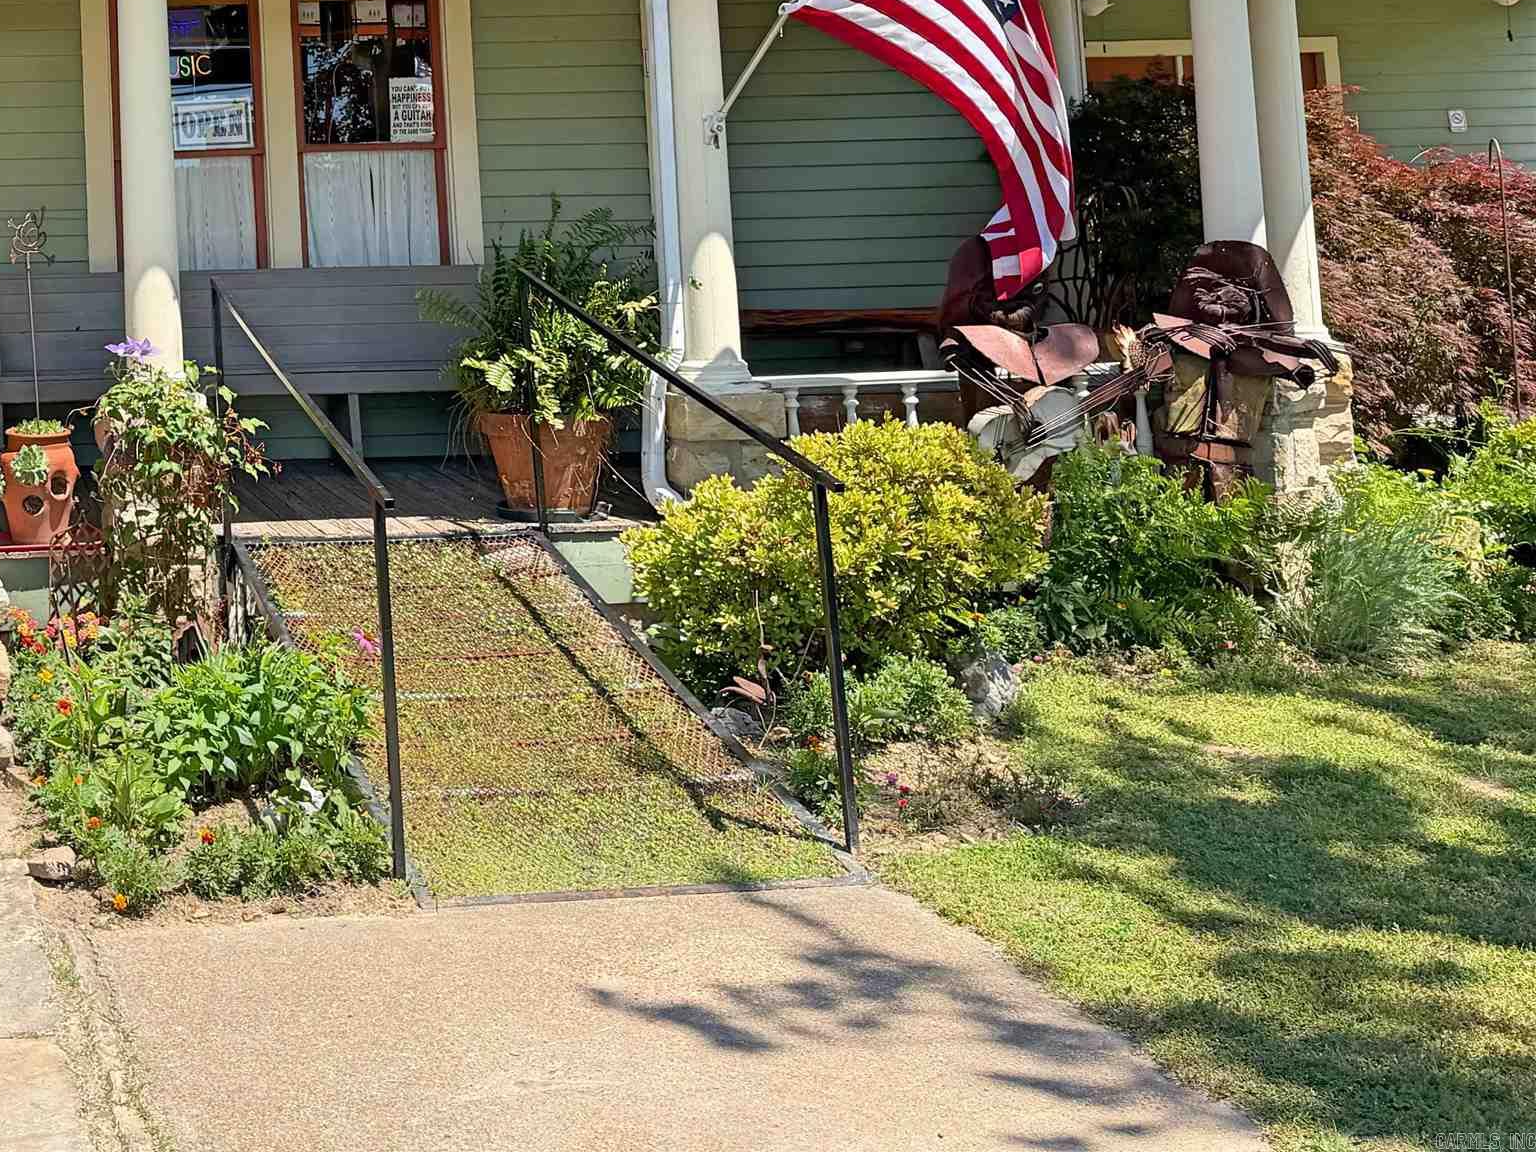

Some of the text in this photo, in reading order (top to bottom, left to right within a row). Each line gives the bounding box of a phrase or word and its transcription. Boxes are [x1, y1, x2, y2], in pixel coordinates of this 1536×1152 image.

[169, 54, 212, 79] USIC
[392, 92, 431, 104] HAPPINESS
[394, 110, 400, 121] A
[182, 112, 243, 138] OPEN
